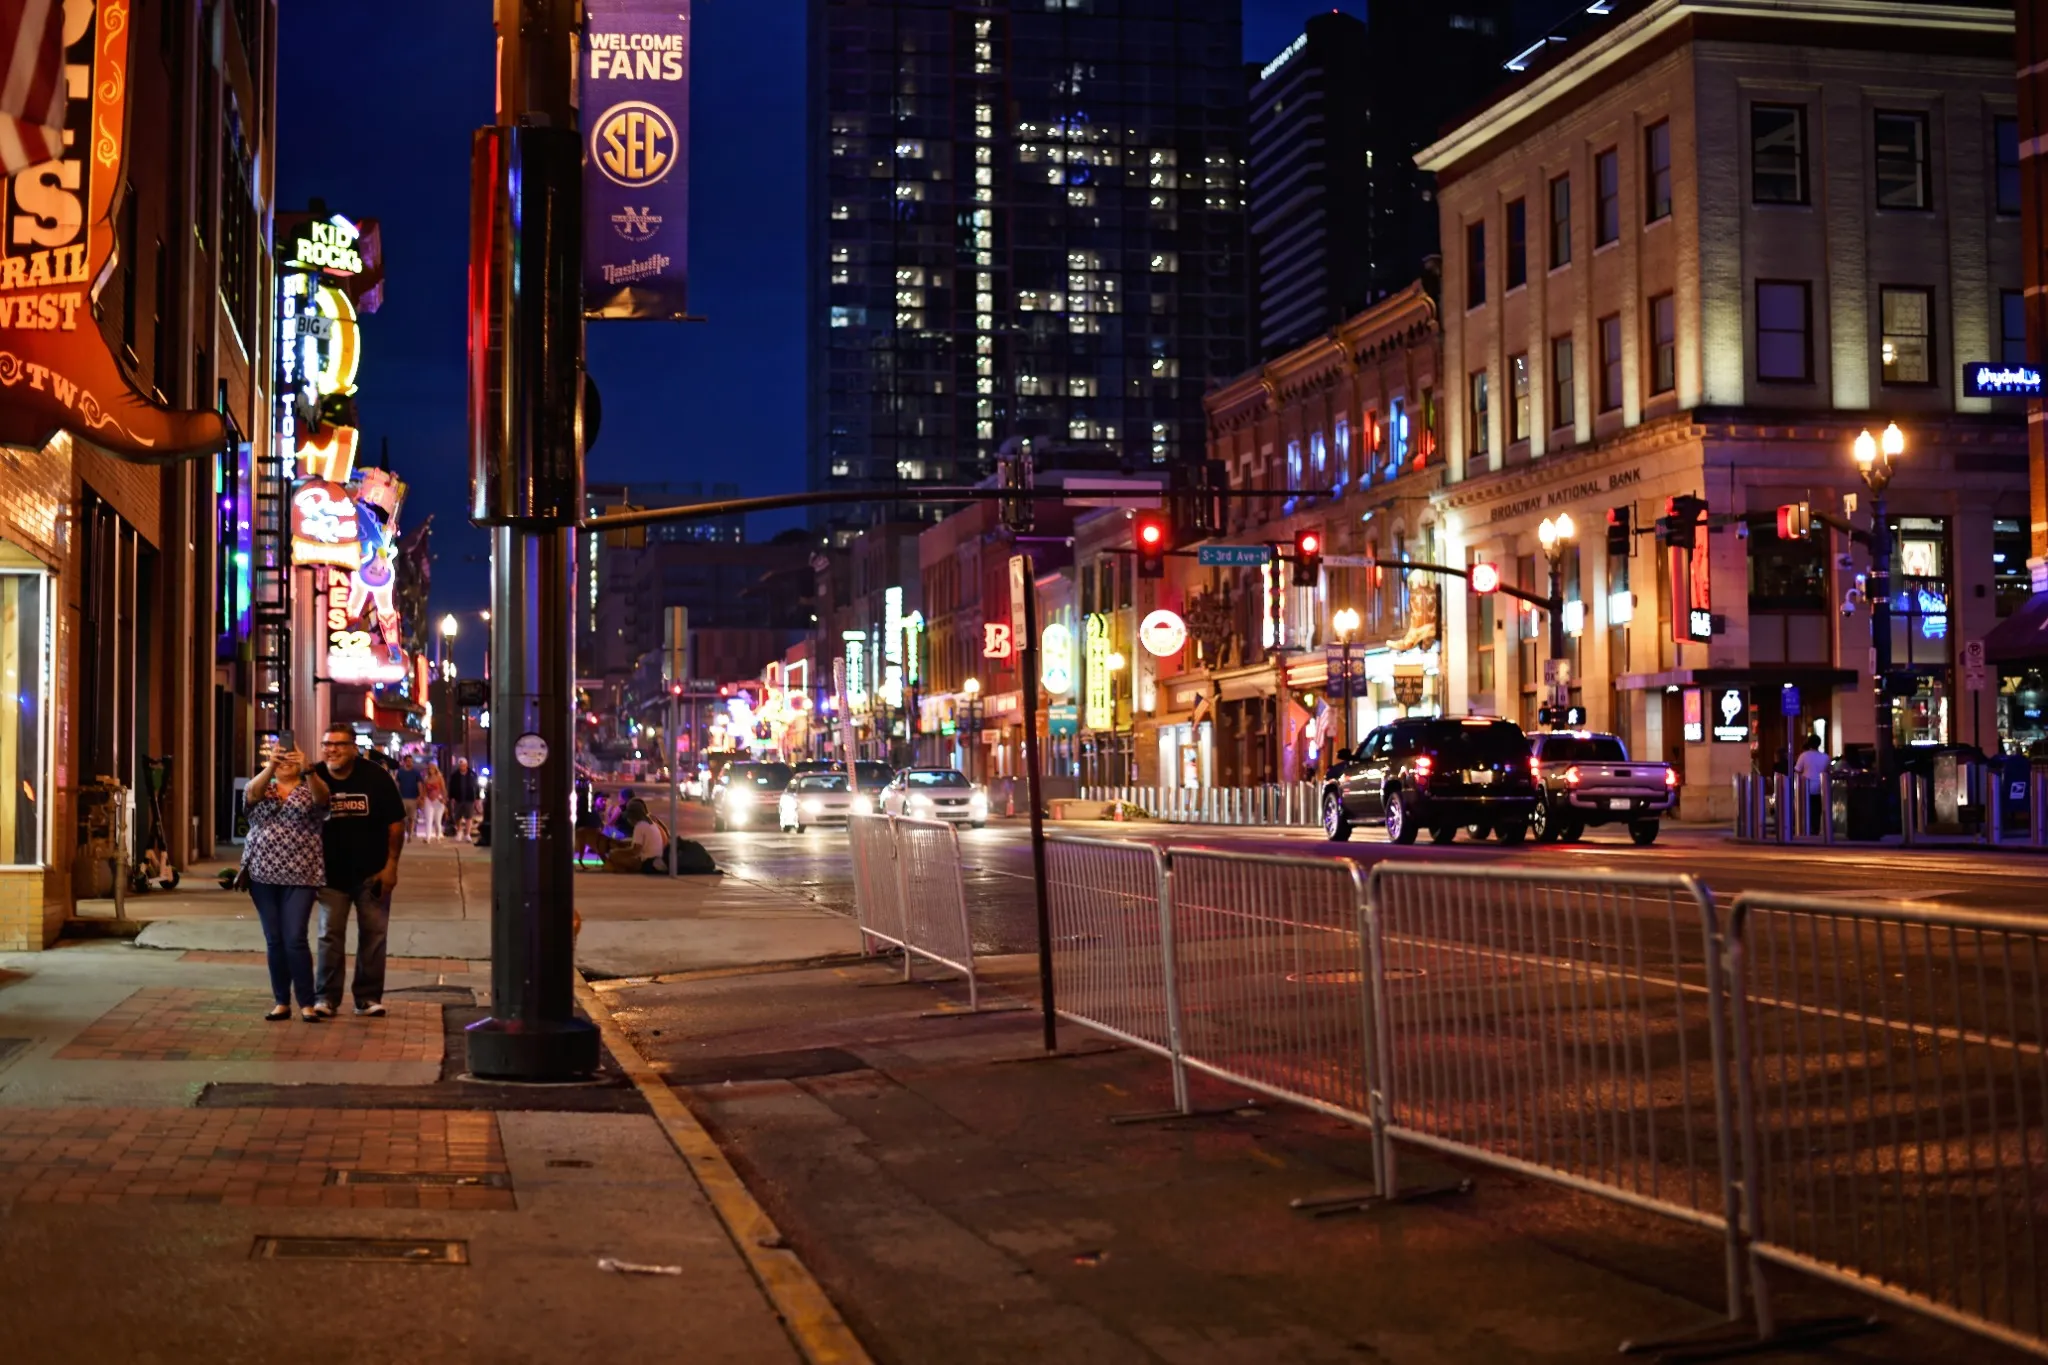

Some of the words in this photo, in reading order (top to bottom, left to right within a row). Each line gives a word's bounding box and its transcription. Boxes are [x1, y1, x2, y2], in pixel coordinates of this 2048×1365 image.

[589, 33, 683, 51] WELCOME
[590, 50, 683, 81] FANS
[602, 111, 667, 179] SEC
[311, 221, 352, 249] KID
[0, 243, 90, 291] RAIL
[297, 316, 321, 335] BIG
[1977, 384, 2041, 393] THERAPY
[1490, 496, 1542, 521] BROADWAY
[1547, 480, 1601, 506] NATIONAL
[1609, 467, 1641, 489] BANK
[330, 630, 372, 657] 32
[983, 623, 1011, 658] B
